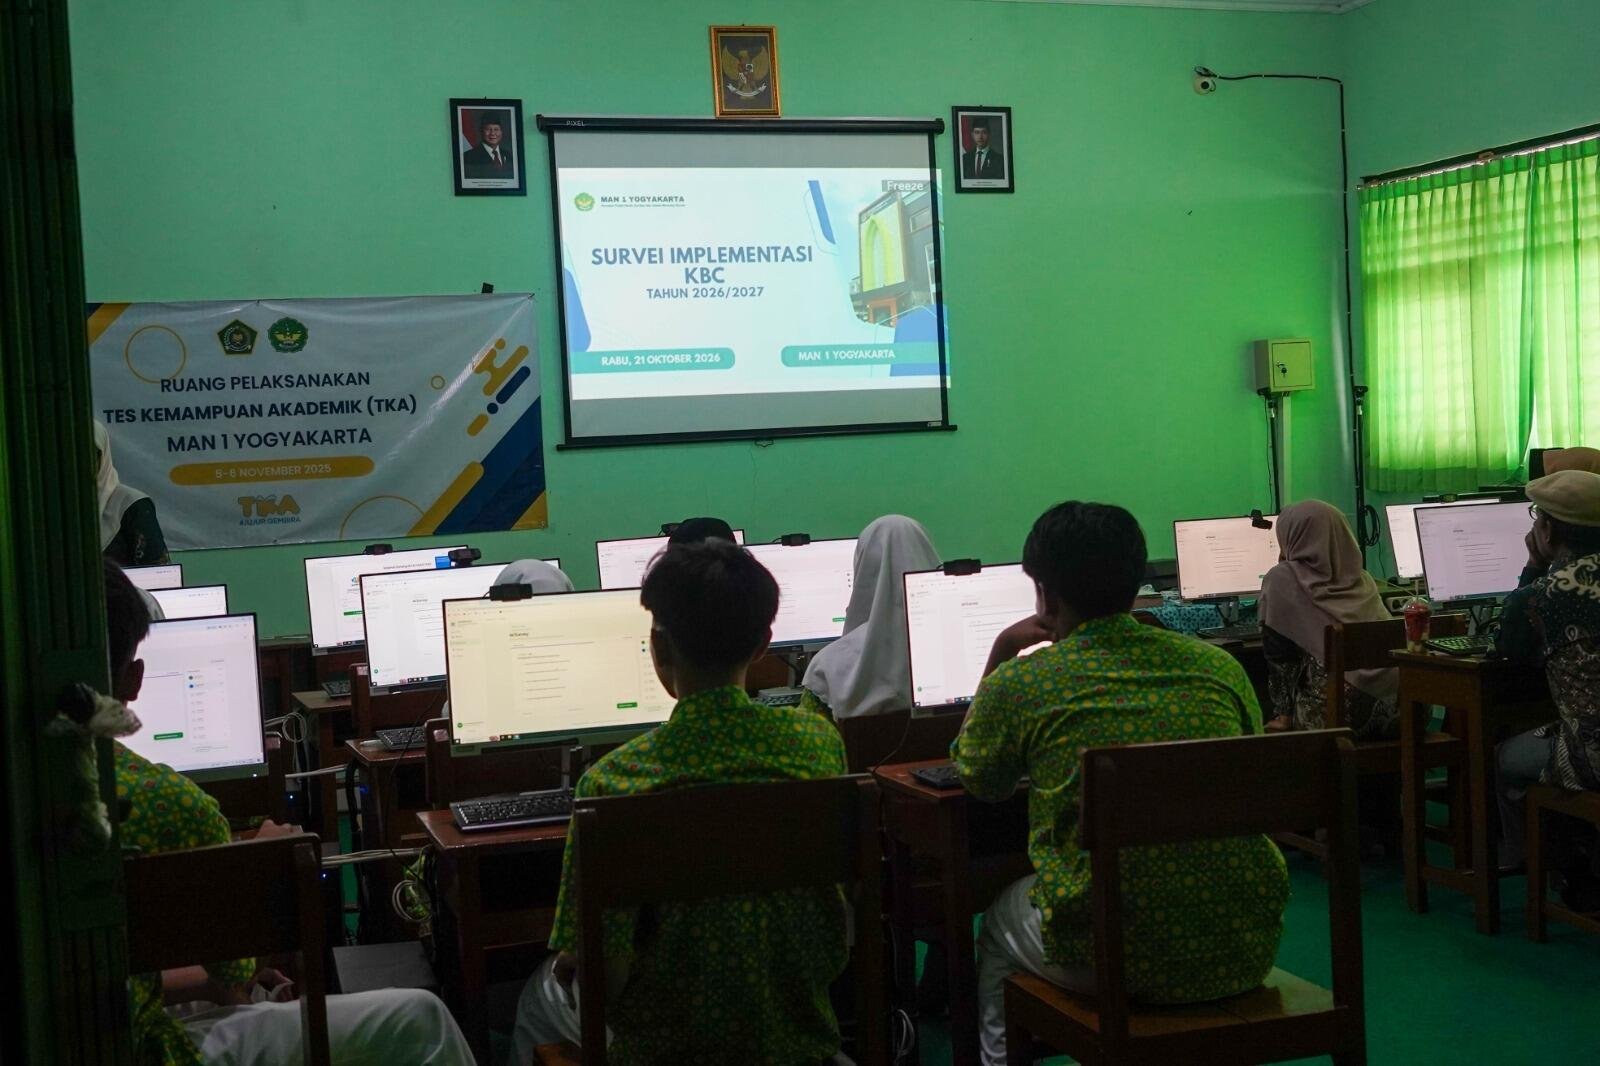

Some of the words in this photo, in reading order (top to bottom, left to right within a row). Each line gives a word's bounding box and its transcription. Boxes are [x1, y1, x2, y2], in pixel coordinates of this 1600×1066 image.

[887, 180, 924, 191] Freeze
[629, 195, 685, 203] YOGYAKARTA
[591, 248, 664, 265] SURVEI
[670, 246, 813, 264] IMPLEMENTASI
[684, 267, 725, 284] KBC
[646, 288, 689, 299] TAHUN
[692, 286, 765, 299] 2026/2027
[601, 356, 632, 366] RABU,
[634, 355, 646, 365] 21
[647, 353, 693, 364] OKTOBER
[694, 352, 721, 363] 2026
[798, 350, 822, 361] MAN
[832, 348, 896, 360] YOGYAKARTA
[160, 377, 226, 393] RUANG
[230, 371, 370, 390] PELAKSANAKAN
[103, 408, 137, 424] TES
[140, 403, 264, 422] KEMAMPUAN
[267, 399, 363, 417] AKADEMIK
[367, 394, 417, 416] (TKA)
[167, 434, 216, 453] MAN
[221, 433, 229, 449] 1
[233, 427, 373, 449] YOGYAKARTA
[239, 465, 302, 478] NOVEMBER
[304, 463, 332, 474] 2025
